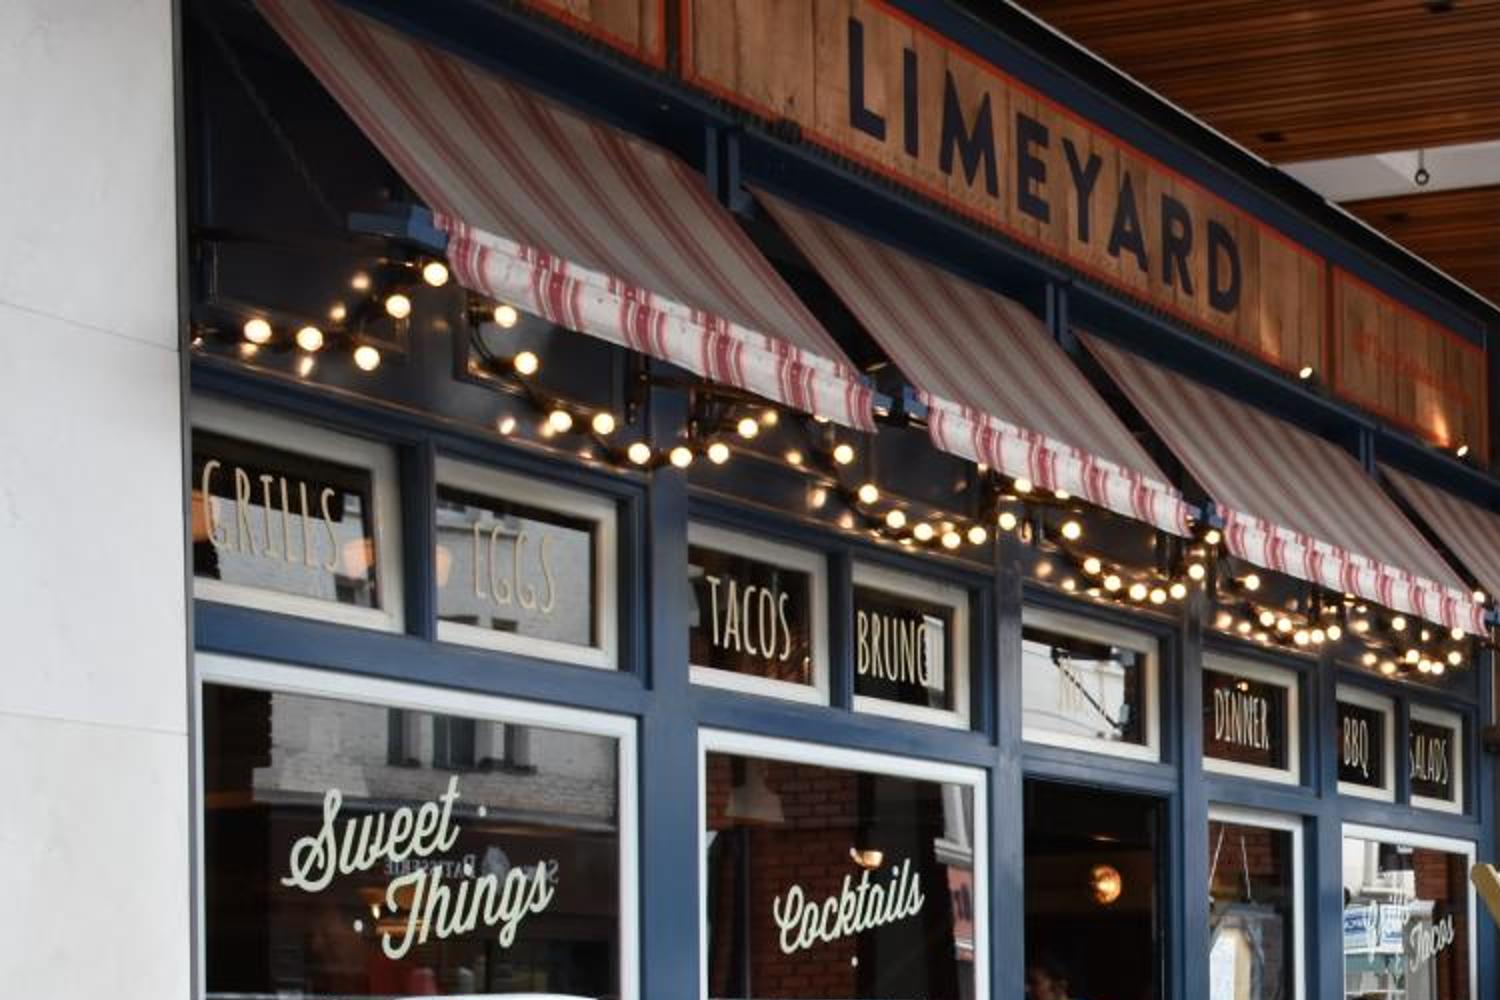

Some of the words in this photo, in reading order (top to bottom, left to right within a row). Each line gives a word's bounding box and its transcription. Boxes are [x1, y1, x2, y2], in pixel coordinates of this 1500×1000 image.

[847, 16, 1242, 314] LIMEYARD
[202, 459, 341, 575] GRILLS
[473, 520, 556, 614] EGGS
[706, 575, 792, 661] TACOS
[857, 610, 943, 690] BRUNC
[1213, 687, 1270, 752] DINNER
[1342, 716, 1370, 779] BBQ
[281, 774, 461, 893] Sweet
[382, 860, 555, 960] Things
[773, 858, 926, 955] Cocktails
